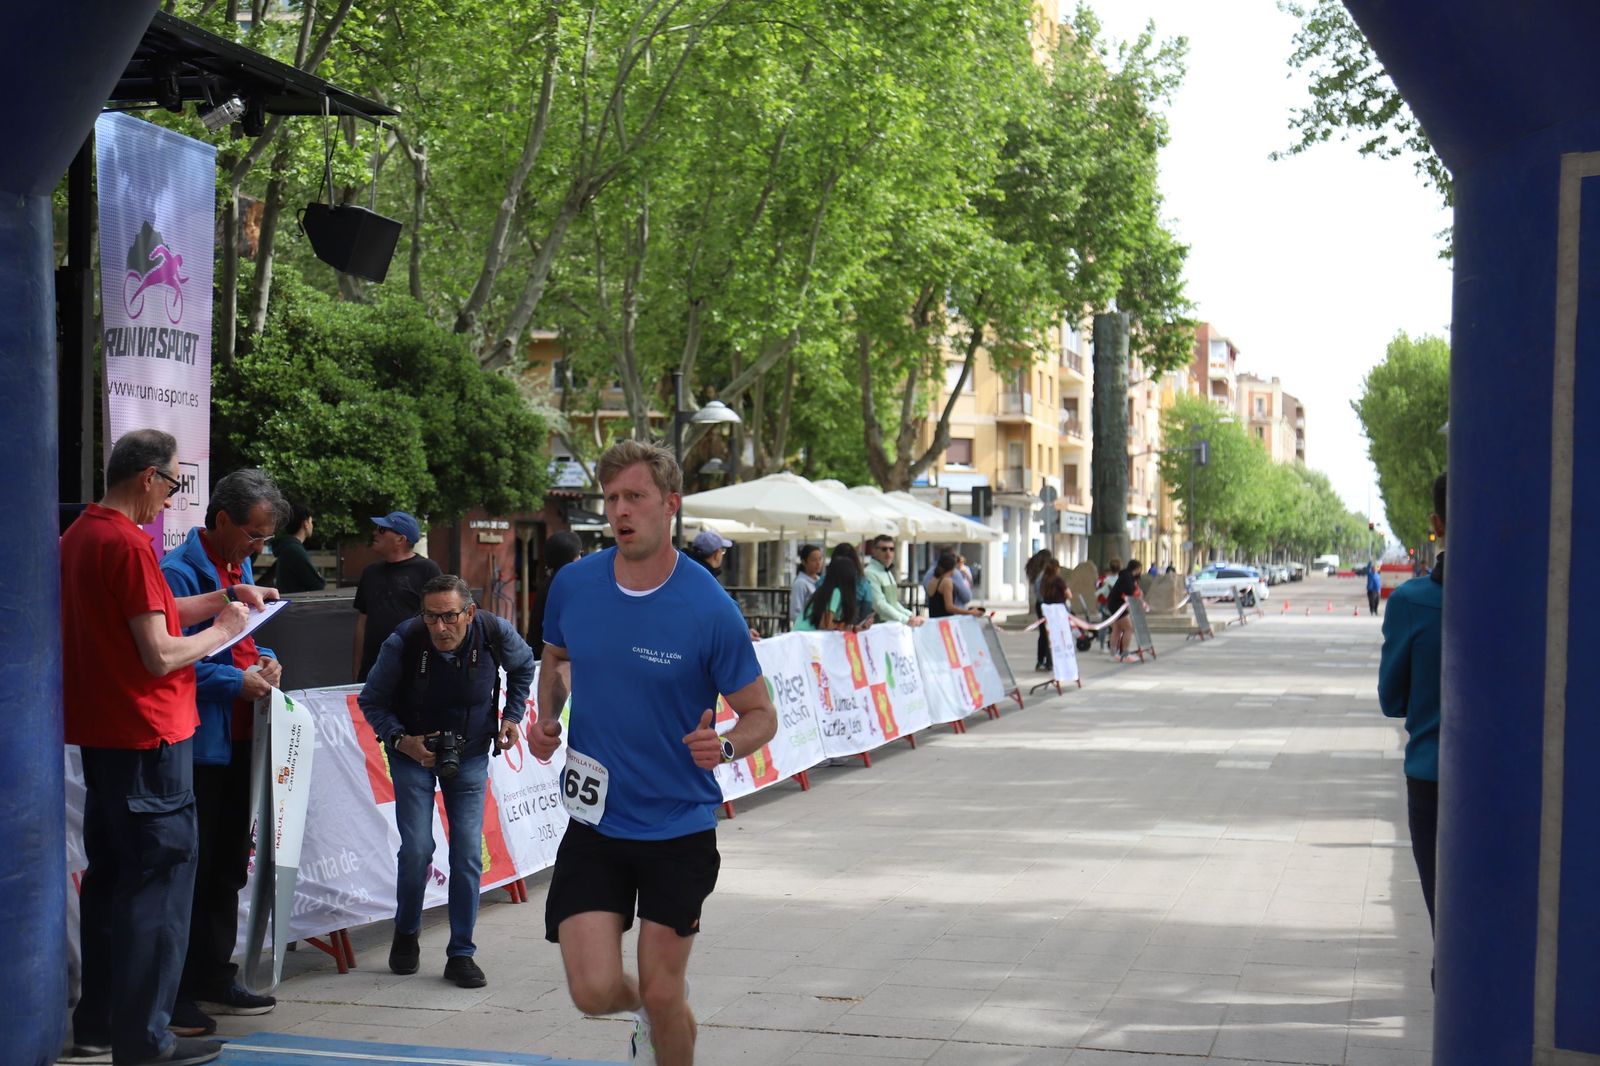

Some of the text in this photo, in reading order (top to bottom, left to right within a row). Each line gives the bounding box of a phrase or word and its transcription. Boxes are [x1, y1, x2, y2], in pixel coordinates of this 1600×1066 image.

[632, 646, 659, 656] CASTILLA
[666, 652, 682, 660] LEÓN
[286, 722, 298, 766] Junta de
[287, 760, 298, 793] Castilla
[294, 724, 302, 749] León
[565, 768, 601, 806] 65
[339, 846, 357, 874] de
